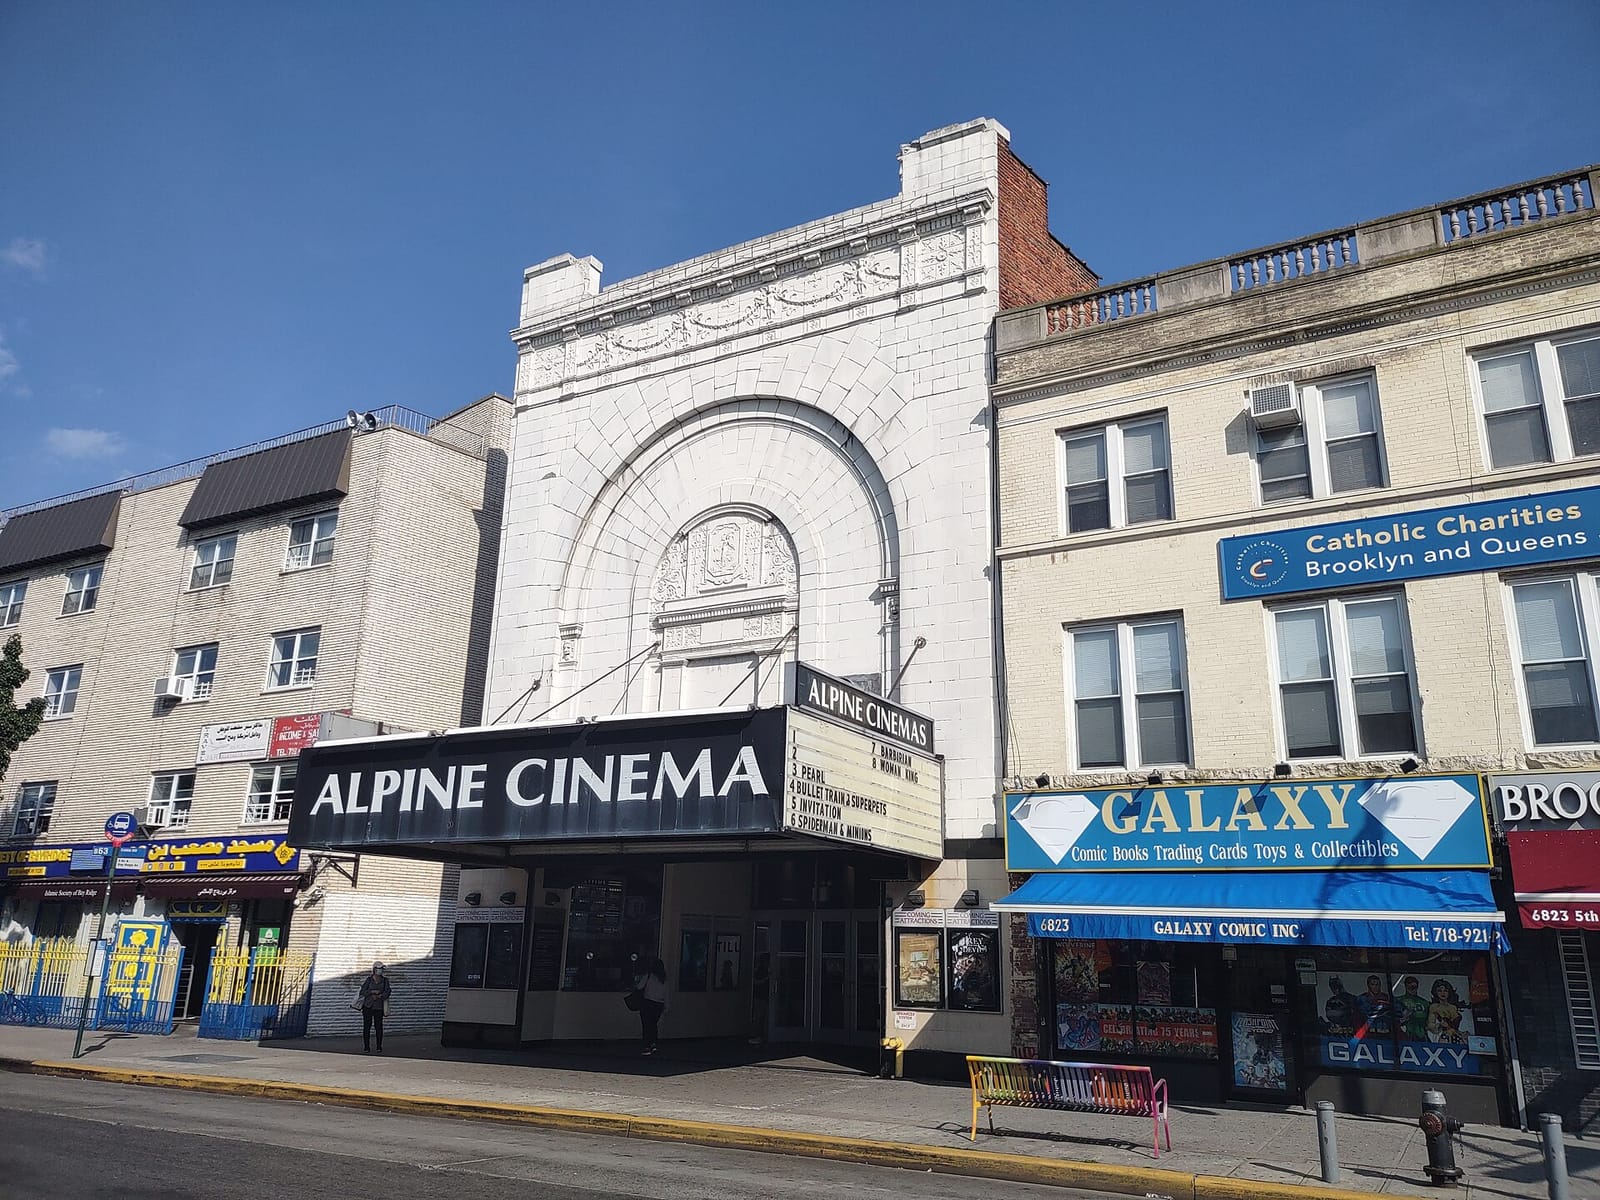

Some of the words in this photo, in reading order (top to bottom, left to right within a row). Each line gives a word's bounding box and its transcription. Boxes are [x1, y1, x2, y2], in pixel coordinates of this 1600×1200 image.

[1305, 523, 1426, 554] Catholic
[1436, 503, 1582, 537] Charities
[1305, 550, 1415, 578] Brooklyn
[1424, 539, 1471, 563] and
[1480, 531, 1588, 557] Queens
[808, 678, 863, 722] ALPINE
[866, 702, 927, 746] CINEMAS
[278, 730, 302, 741] INCOME
[792, 730, 796, 743] 1
[792, 746, 797, 759] 2
[871, 742, 876, 753] 7
[309, 763, 488, 816] ALPINE
[505, 745, 769, 808] CINEMA
[792, 763, 797, 776] 3
[801, 766, 825, 784] PEARL
[872, 758, 877, 769] 8
[880, 759, 901, 778] WOMAN
[905, 769, 919, 784] KING
[789, 780, 795, 793] 4
[797, 781, 824, 800] BULLET
[824, 788, 845, 806] TRAIN
[851, 795, 887, 816] SUPERPETS
[791, 796, 796, 810] 5
[799, 798, 842, 820] INVITATION
[1101, 783, 1356, 834] GALAXY
[791, 813, 796, 826] 6
[798, 814, 839, 836] SPIDERMAN
[839, 824, 844, 837] &
[226, 839, 276, 858] مسجد
[1071, 845, 1108, 861] Comic
[1113, 845, 1149, 861] Books
[1154, 844, 1203, 864] Trading
[1209, 842, 1248, 861] Cards
[1253, 842, 1287, 863] Toys
[1294, 843, 1305, 858] &
[1311, 840, 1399, 860] Collectibles
[44, 889, 58, 897] Islamic
[58, 889, 72, 898] Society
[72, 889, 78, 897] of
[86, 889, 98, 897] Ridge
[952, 918, 992, 926] ATTRACTIONS
[1040, 917, 1070, 932] 6823
[1532, 910, 1569, 921] 6823
[1575, 910, 1600, 922] 5th
[1153, 921, 1213, 937] GALAXY
[1218, 923, 1266, 938] COMIC
[1272, 923, 1305, 939] INC.
[1405, 927, 1429, 942] Tel:
[716, 941, 740, 952] TILL
[1160, 1027, 1171, 1037] 75
[1174, 1027, 1200, 1039] YEARS
[1328, 1041, 1468, 1069] GALAXY
